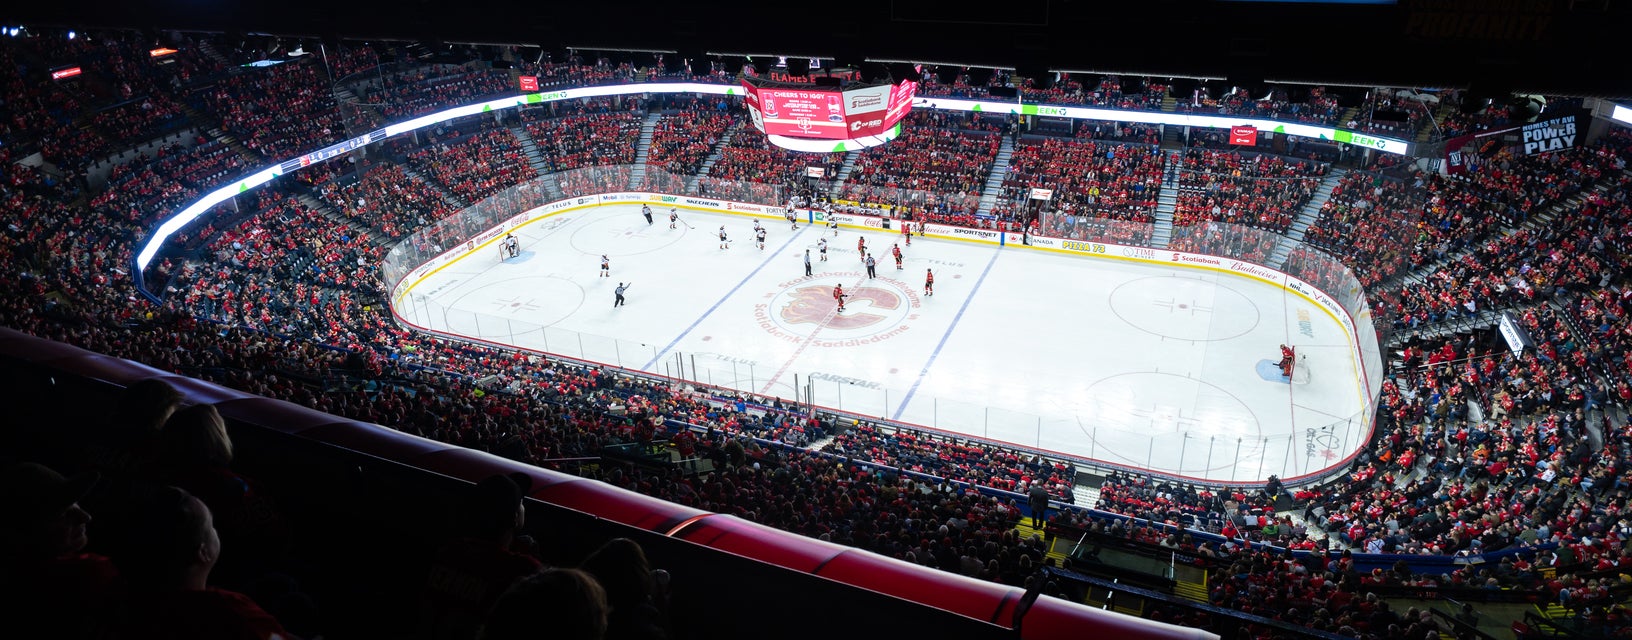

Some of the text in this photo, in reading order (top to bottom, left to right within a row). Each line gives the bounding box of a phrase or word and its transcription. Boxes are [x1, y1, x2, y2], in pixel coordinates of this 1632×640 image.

[771, 72, 808, 83] FLAMES
[1522, 120, 1549, 132] HOMES
[1561, 115, 1575, 124] AVI
[1523, 123, 1577, 143] POWER
[1524, 134, 1576, 155] PLAY
[649, 194, 678, 203] SUBWAY
[686, 199, 720, 207] SKECHERS
[552, 201, 572, 209] TELUS
[733, 203, 762, 213] Scotiabank
[510, 213, 530, 228] Coca-Cola
[954, 228, 998, 239] SPORTSNET
[1062, 240, 1106, 254] PIZZA 73
[1134, 248, 1156, 257] TIME
[1182, 255, 1221, 266] Scotiabank
[1230, 262, 1278, 281] Budweiser
[754, 303, 910, 348] Scotiabank Saddledome
